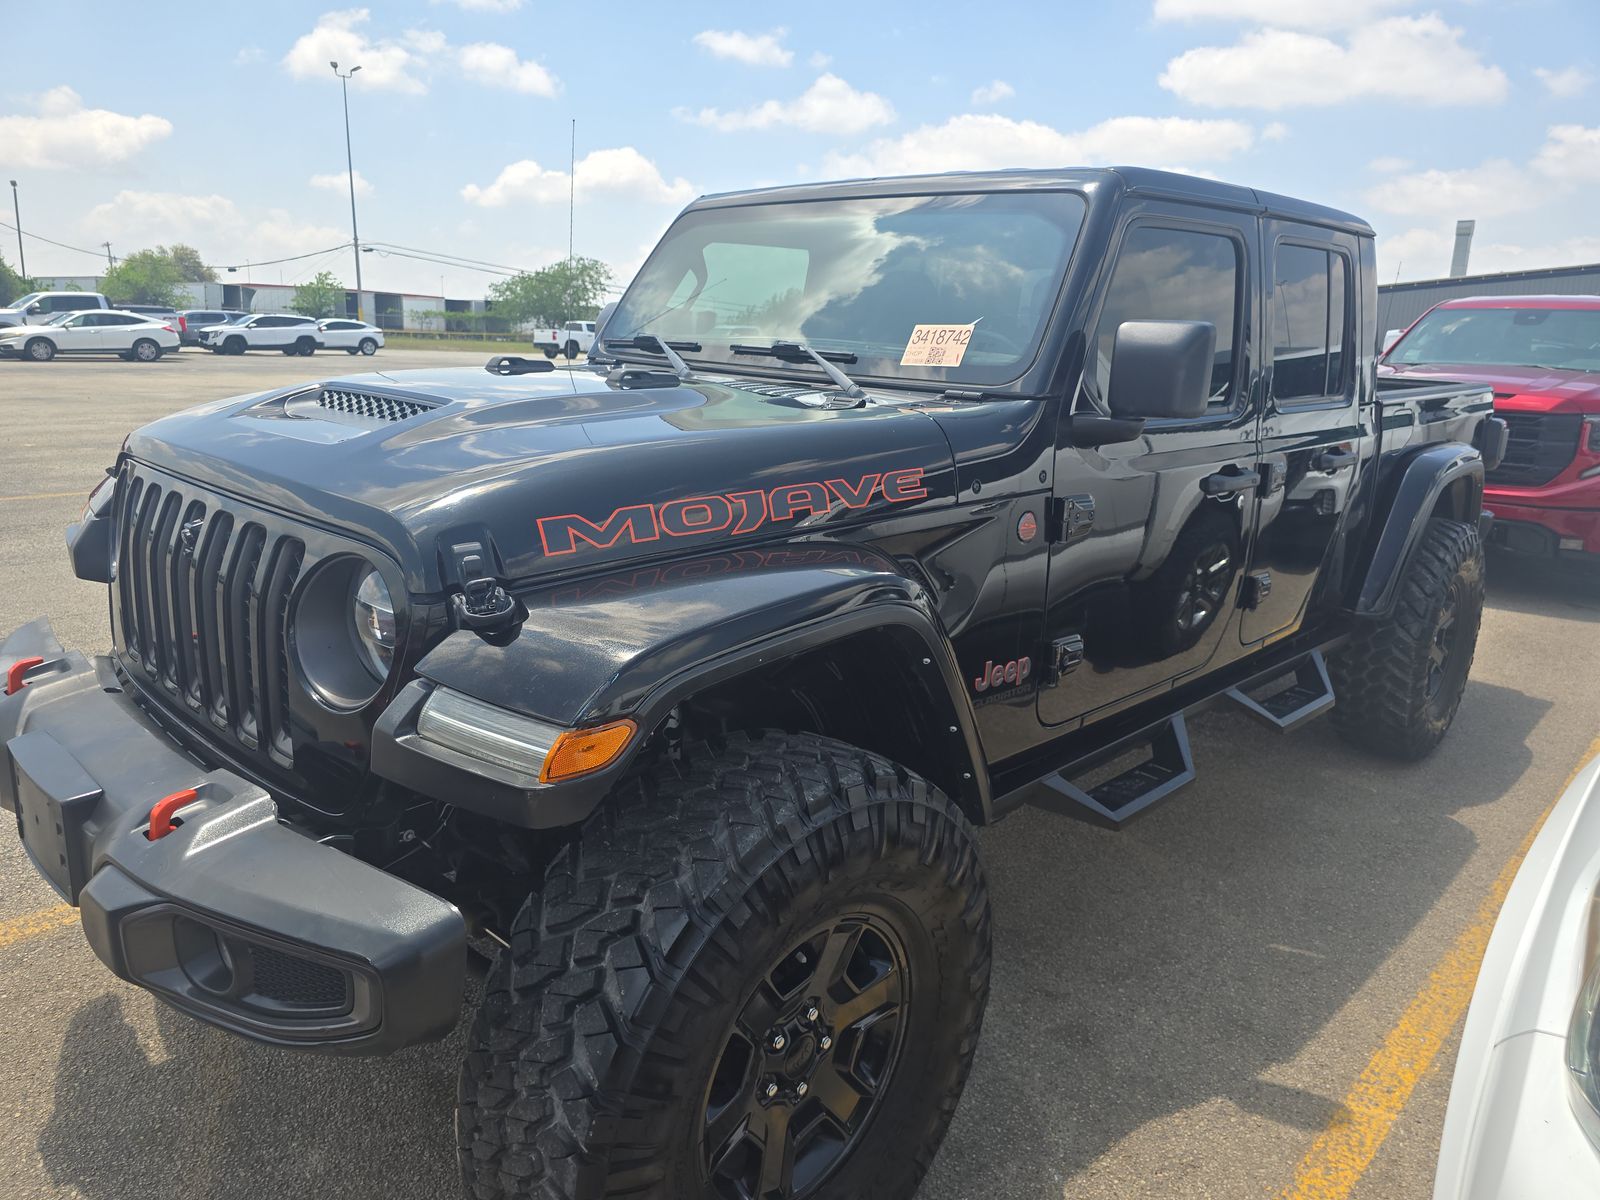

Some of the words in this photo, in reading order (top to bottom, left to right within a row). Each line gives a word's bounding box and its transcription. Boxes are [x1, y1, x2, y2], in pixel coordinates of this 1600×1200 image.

[912, 329, 971, 344] 3418742
[537, 468, 928, 556] MOJAVE
[975, 656, 1031, 692] Jeep
